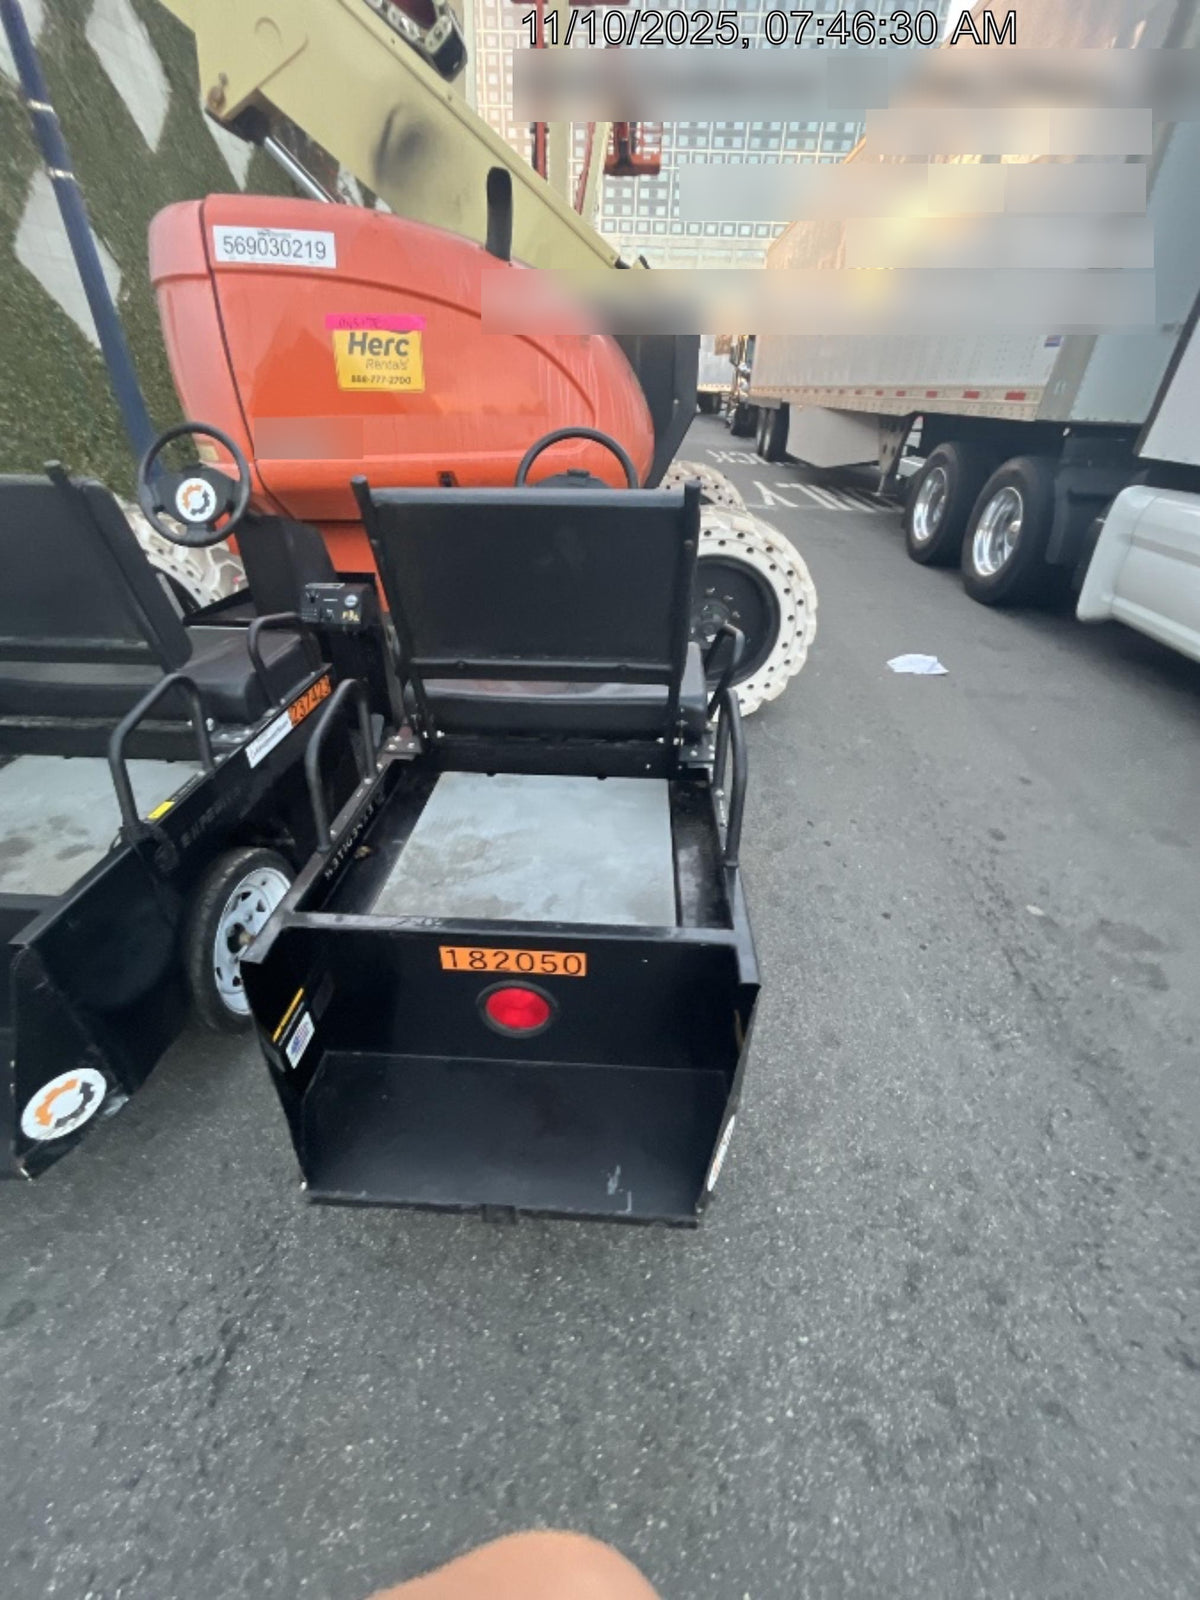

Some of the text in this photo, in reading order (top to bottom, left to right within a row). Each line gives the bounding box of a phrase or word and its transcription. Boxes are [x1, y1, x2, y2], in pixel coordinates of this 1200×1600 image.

[223, 235, 327, 260] 569030219
[347, 331, 410, 357] Herc
[365, 358, 409, 370] Rentals
[445, 948, 583, 976] 182050
